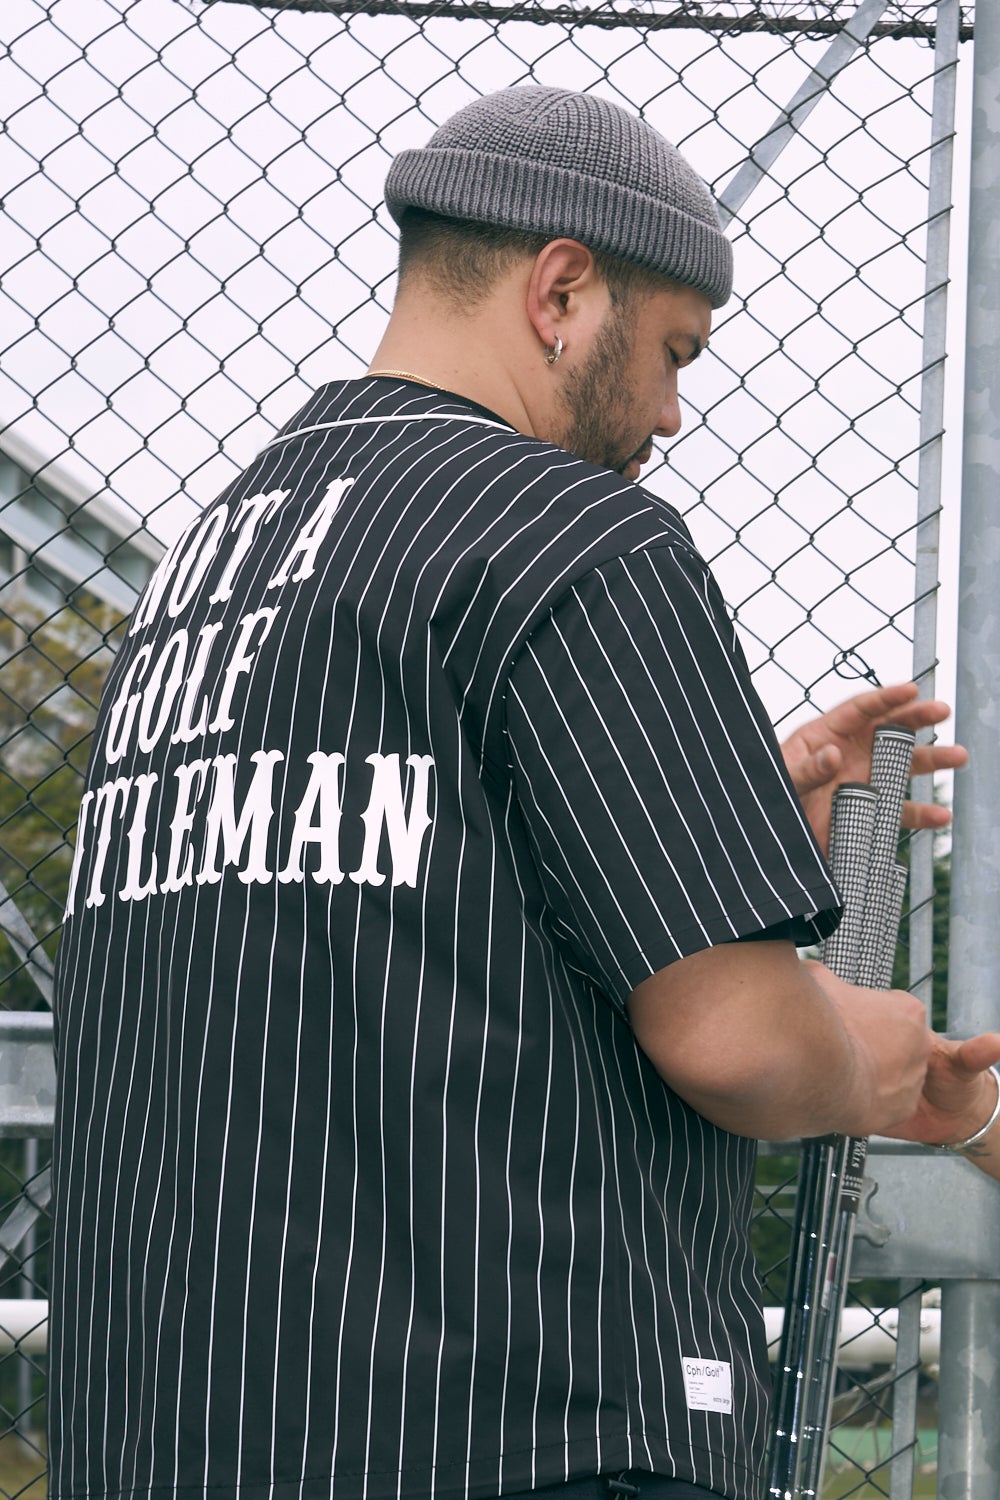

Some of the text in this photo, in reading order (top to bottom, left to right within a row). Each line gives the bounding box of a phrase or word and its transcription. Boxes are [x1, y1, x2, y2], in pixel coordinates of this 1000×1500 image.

[129, 477, 355, 637] NOT A
[105, 606, 281, 764] GOLF
[62, 749, 436, 923] TLEMAN
